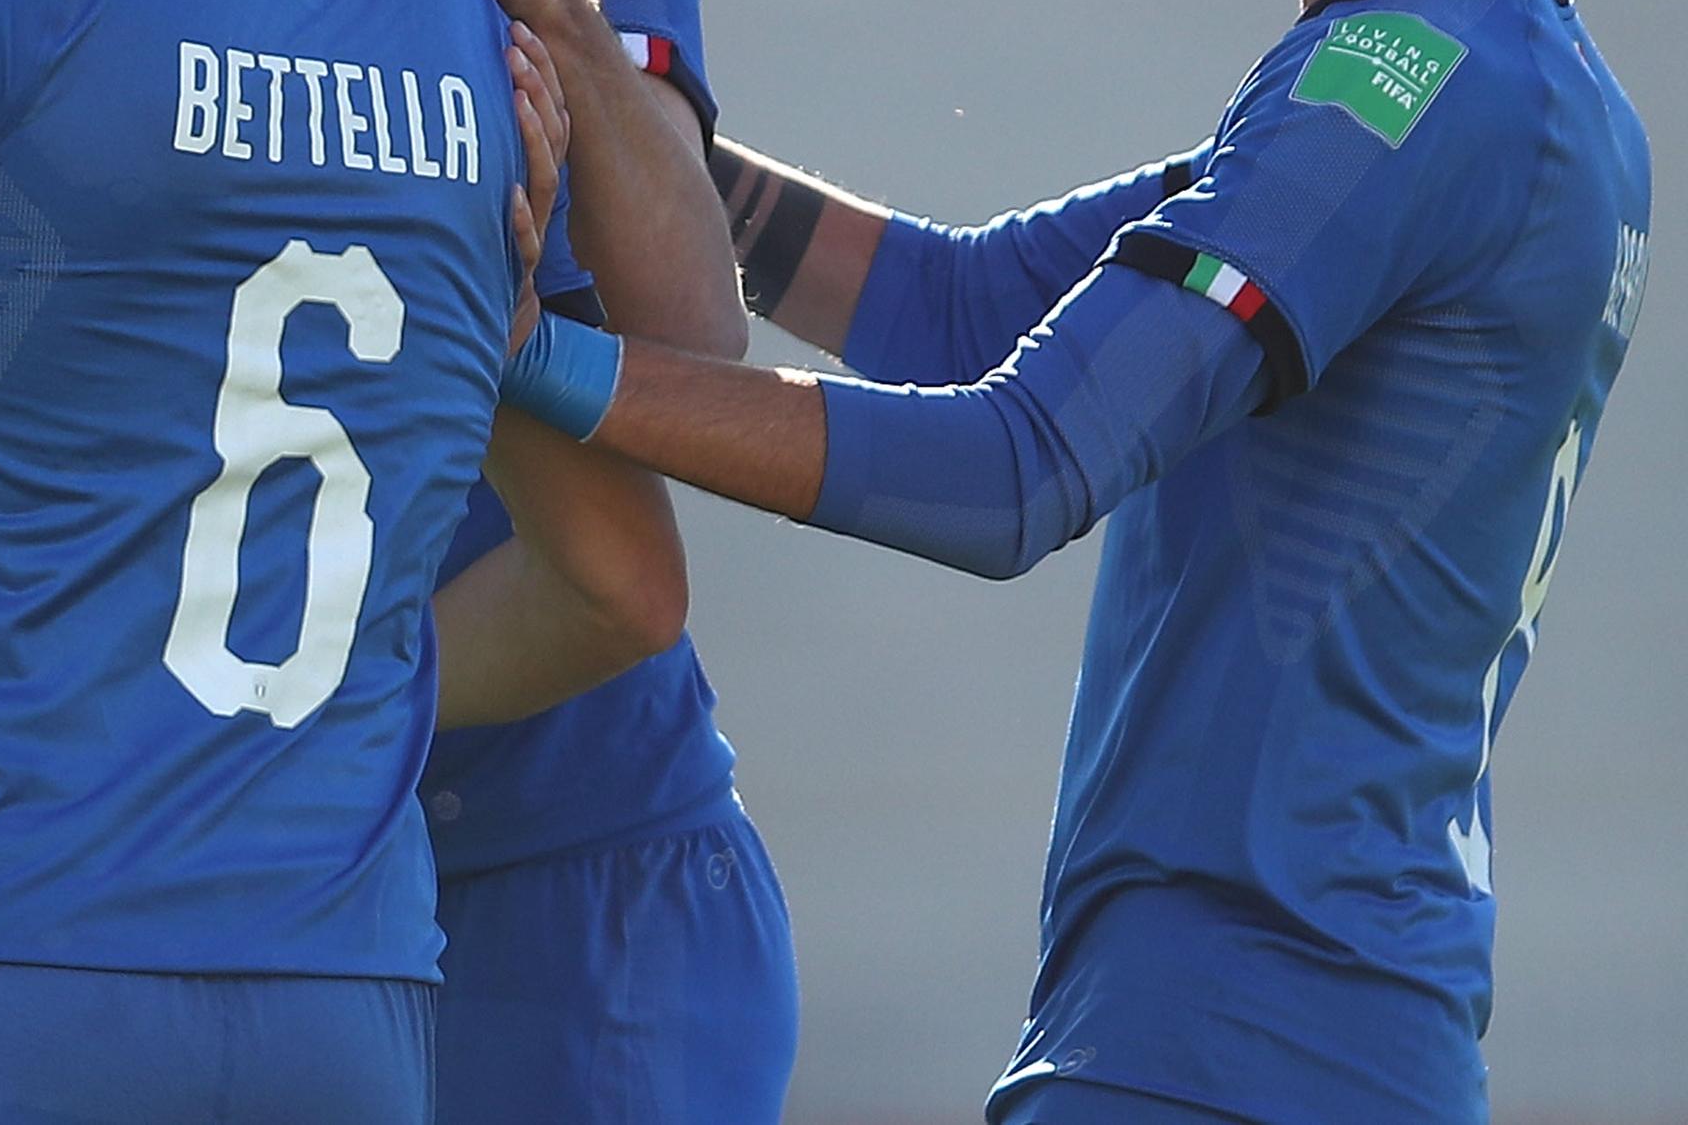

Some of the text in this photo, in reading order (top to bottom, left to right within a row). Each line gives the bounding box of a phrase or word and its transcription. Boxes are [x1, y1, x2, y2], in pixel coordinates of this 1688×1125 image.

[1340, 21, 1441, 74] LIVING
[1371, 70, 1414, 110] FIFA
[173, 40, 480, 185] BETTELLA
[162, 238, 406, 731] 6
